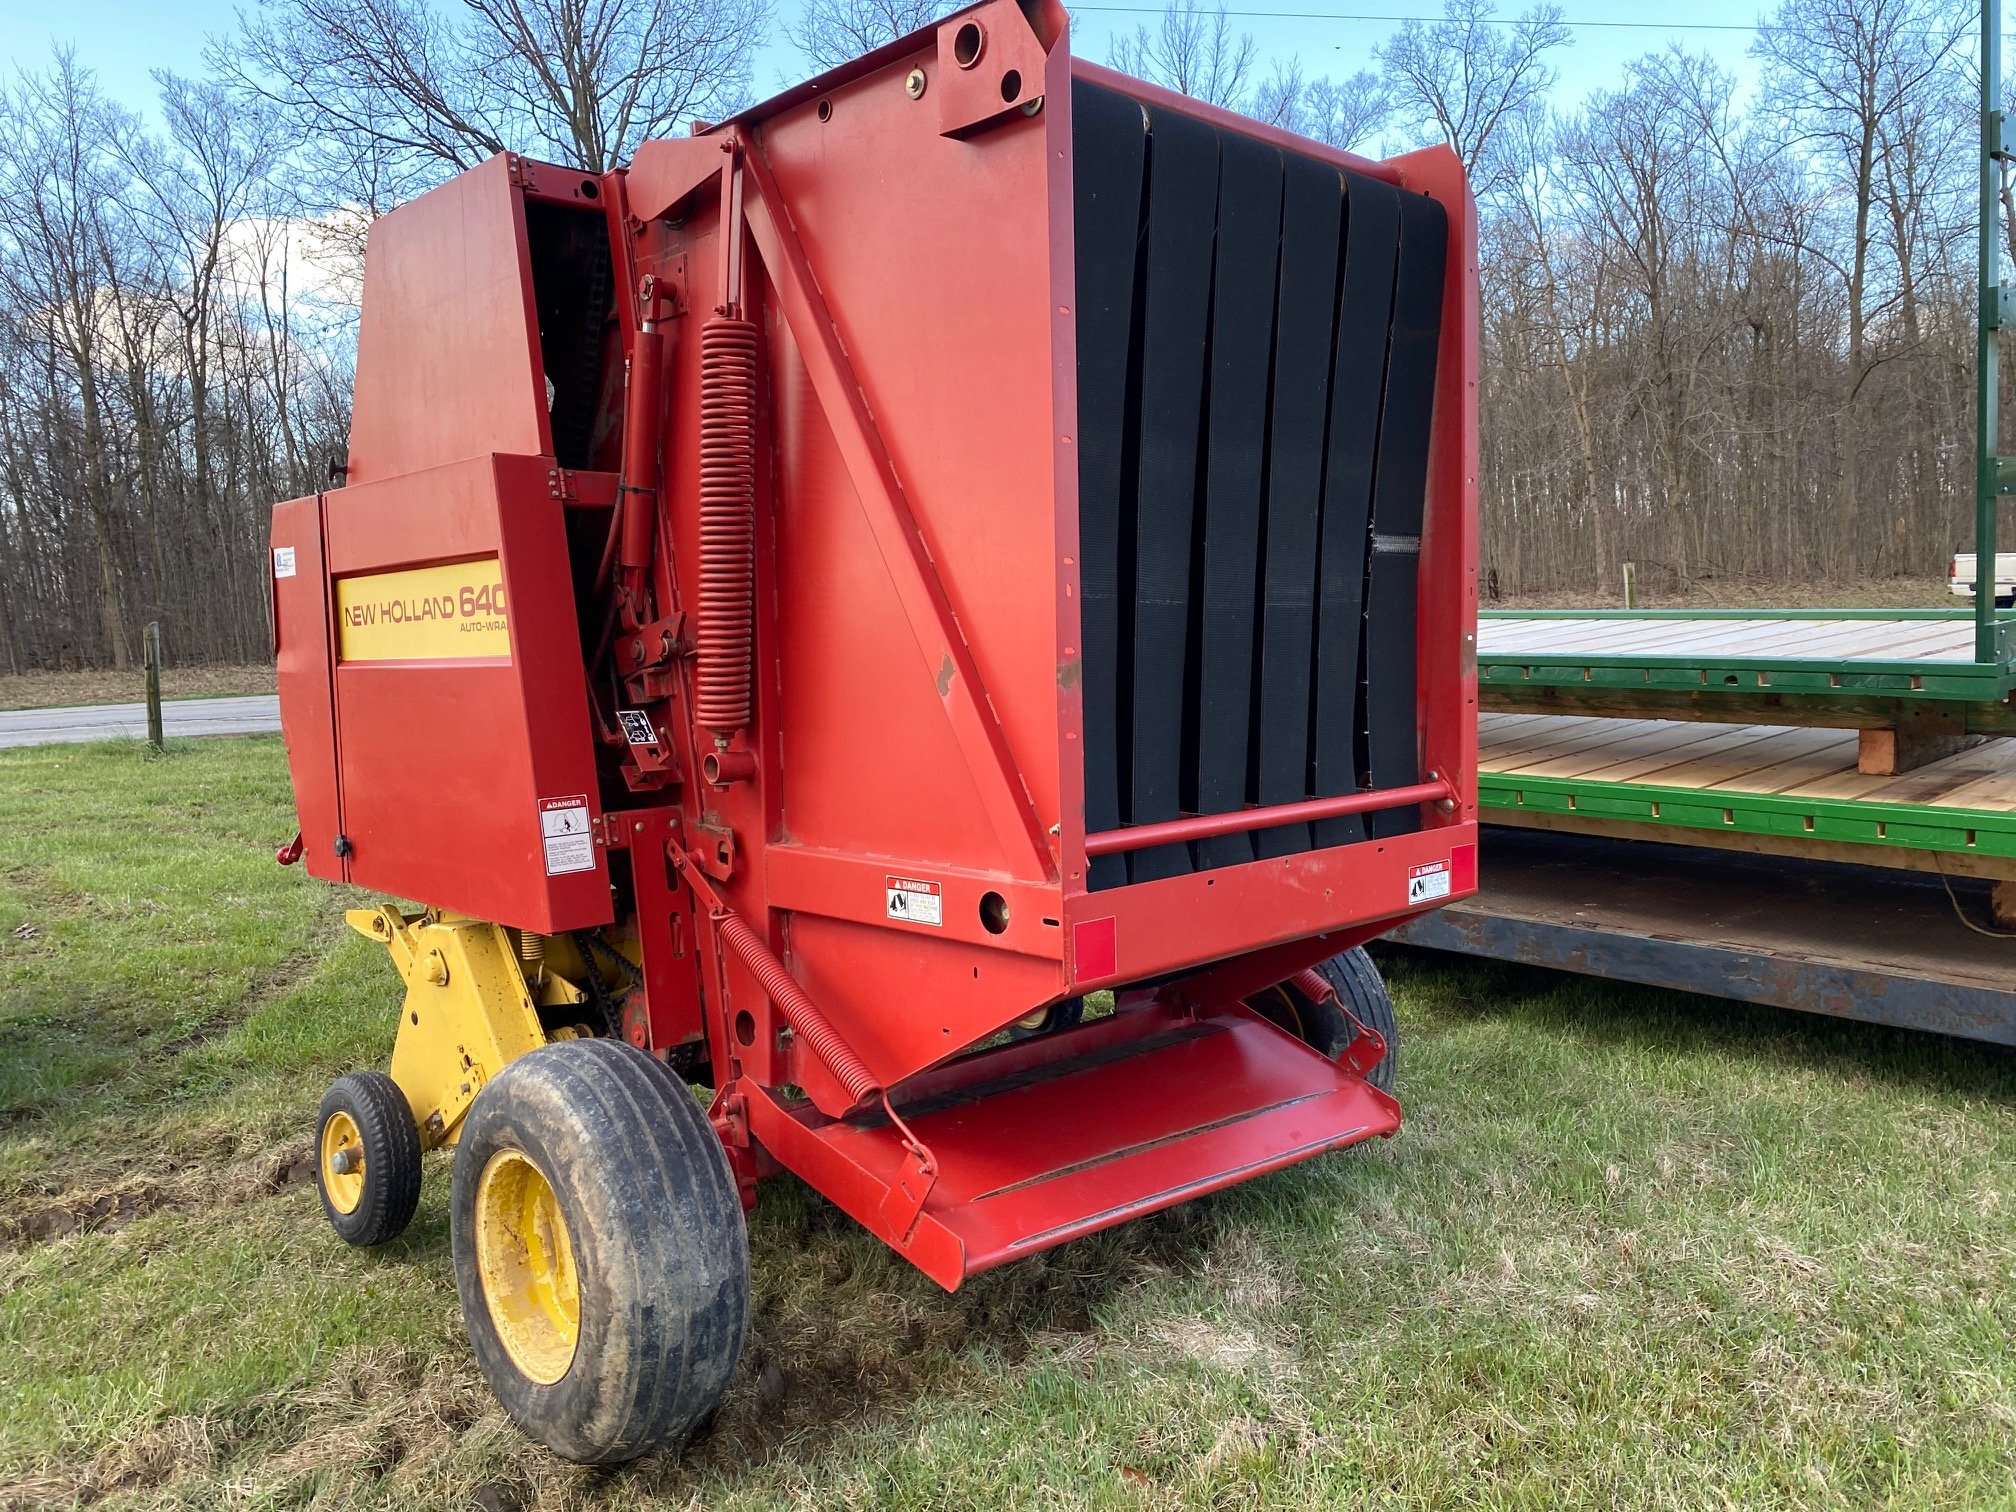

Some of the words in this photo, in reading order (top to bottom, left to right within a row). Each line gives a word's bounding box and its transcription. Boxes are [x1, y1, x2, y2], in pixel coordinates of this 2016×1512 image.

[345, 604, 376, 627] NEW
[380, 595, 455, 624] HOLLAND
[459, 583, 508, 618] 640
[460, 620, 508, 633] AUTO-WRA
[552, 799, 581, 808] DANGER
[1422, 863, 1442, 874] DANGER
[902, 881, 931, 893] DANGER
